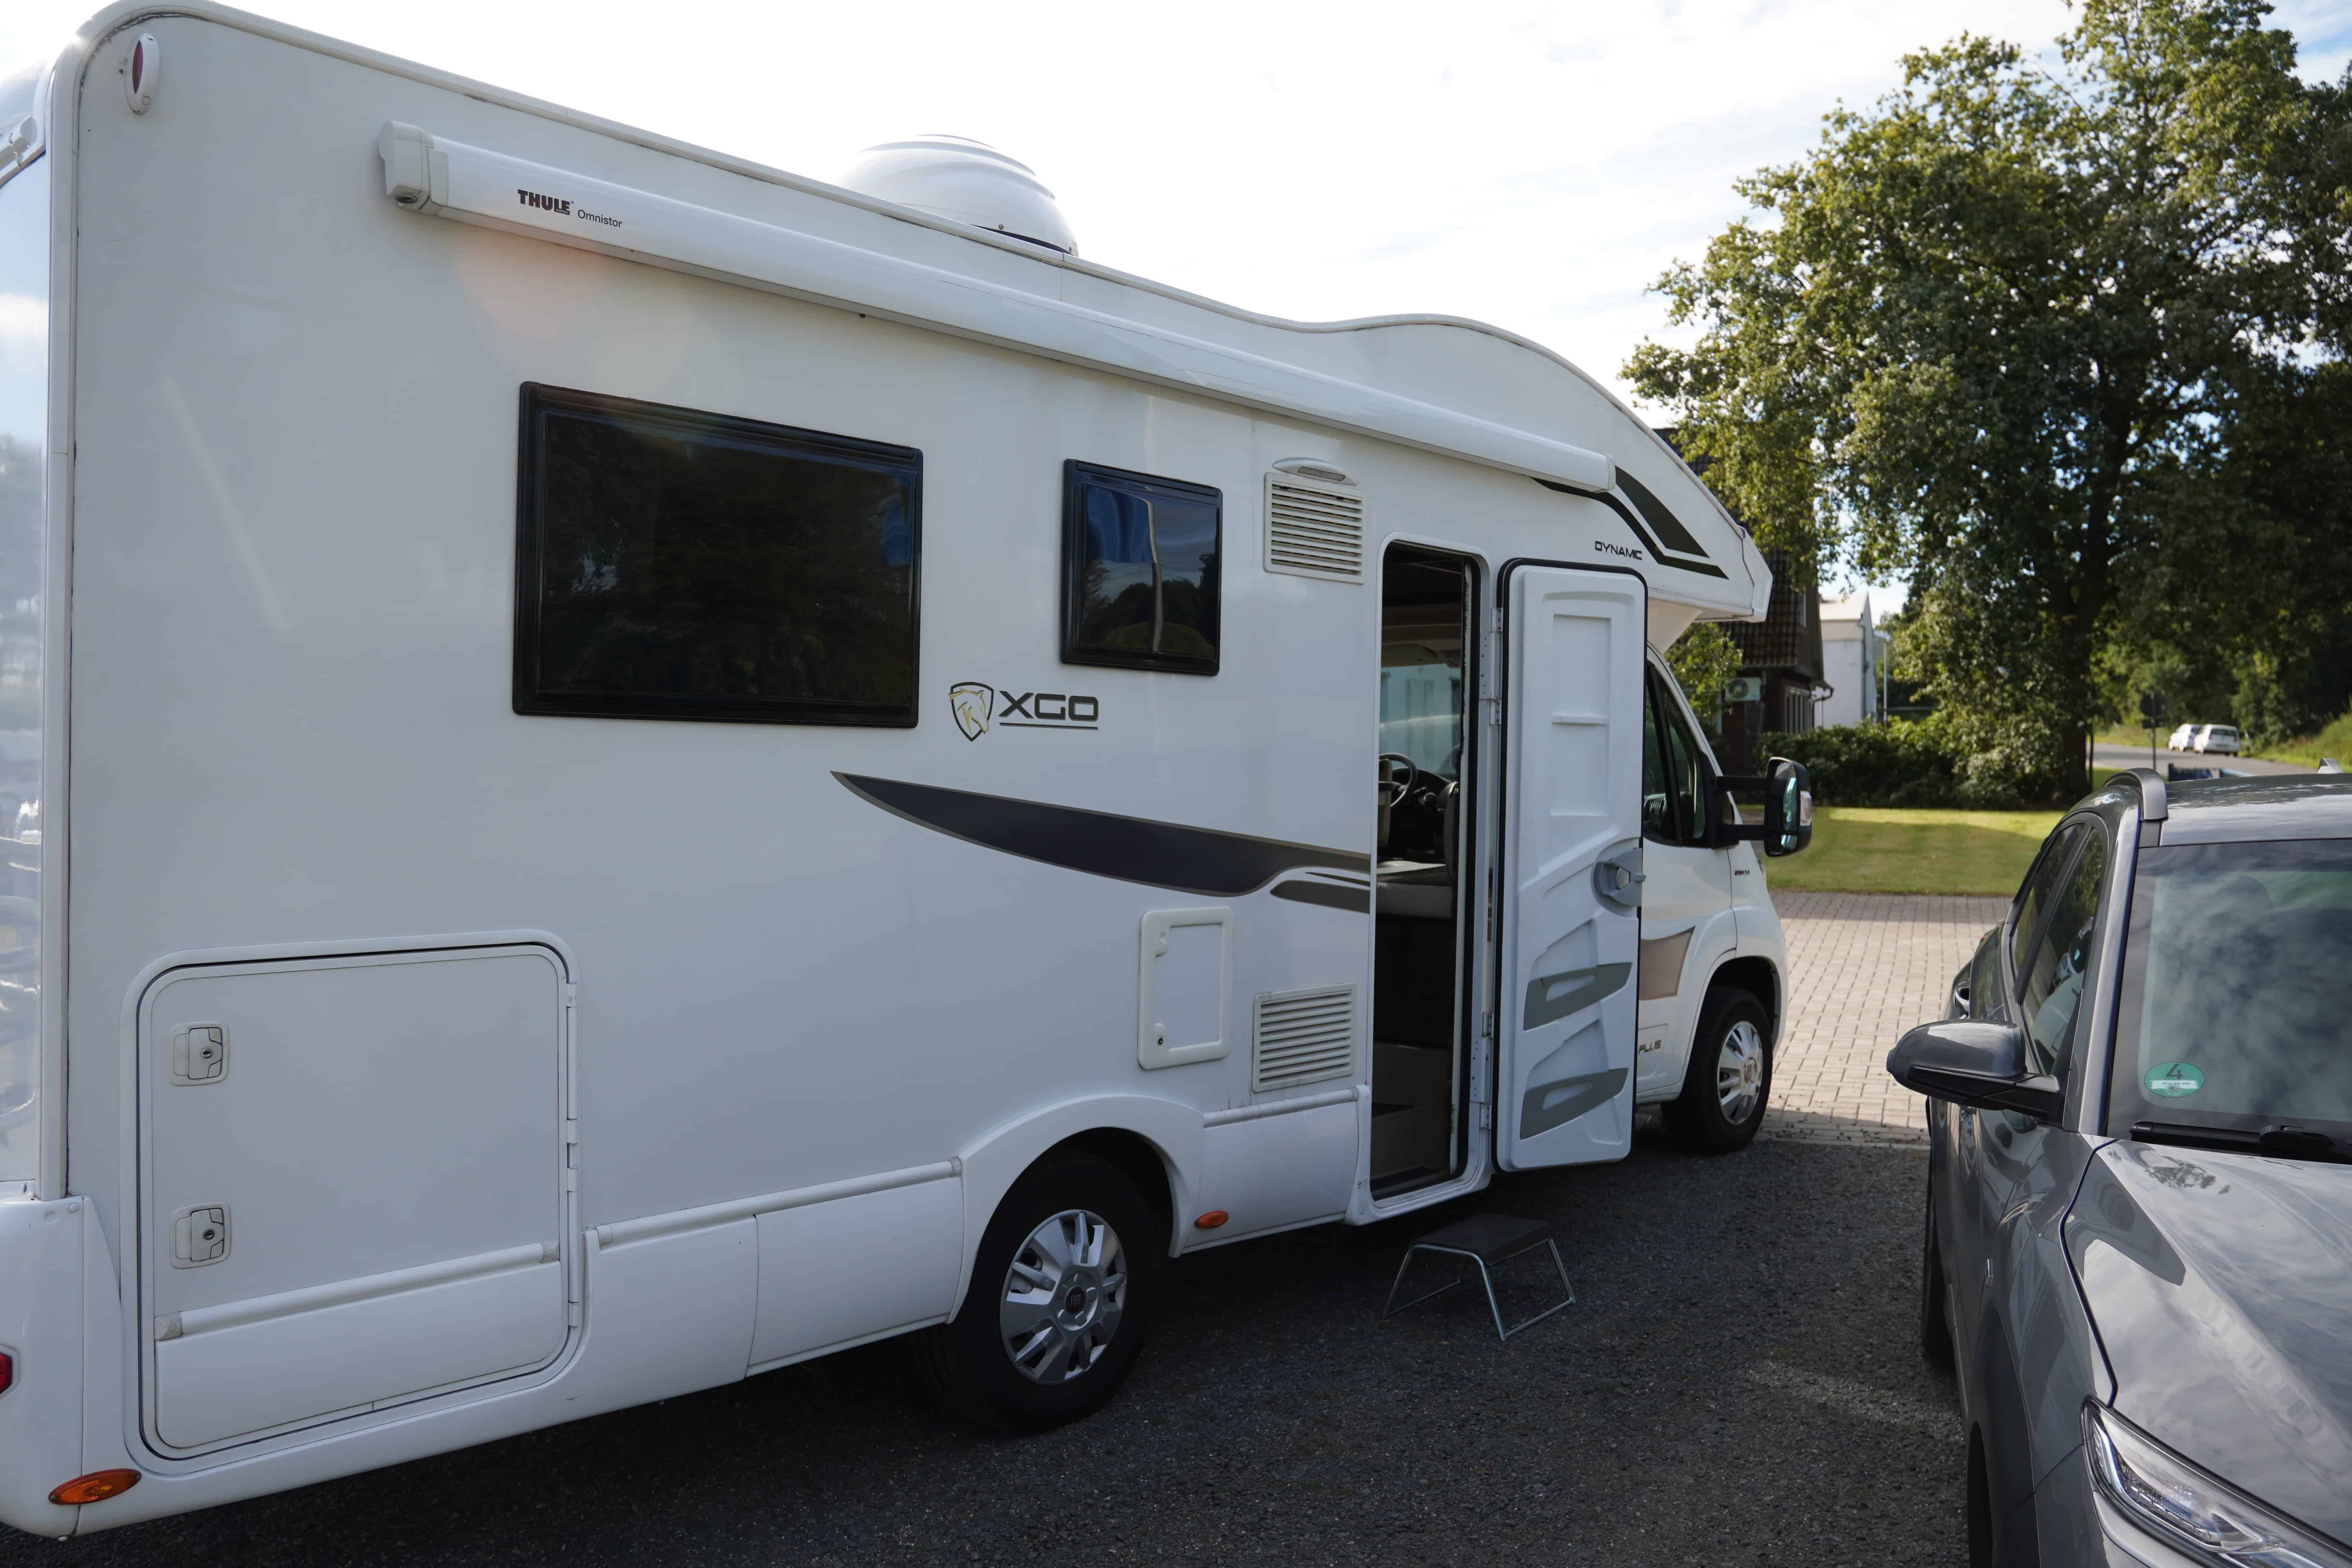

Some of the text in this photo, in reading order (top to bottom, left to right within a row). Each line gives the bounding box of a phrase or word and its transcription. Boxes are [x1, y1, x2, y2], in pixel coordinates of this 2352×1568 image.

[518, 189, 622, 227] THULE Omnistor
[1595, 541, 1642, 561] DYNAMIC
[998, 690, 1098, 722] XGO
[2167, 1063, 2183, 1079] 4
[1070, 1294, 1082, 1307] FIAT
